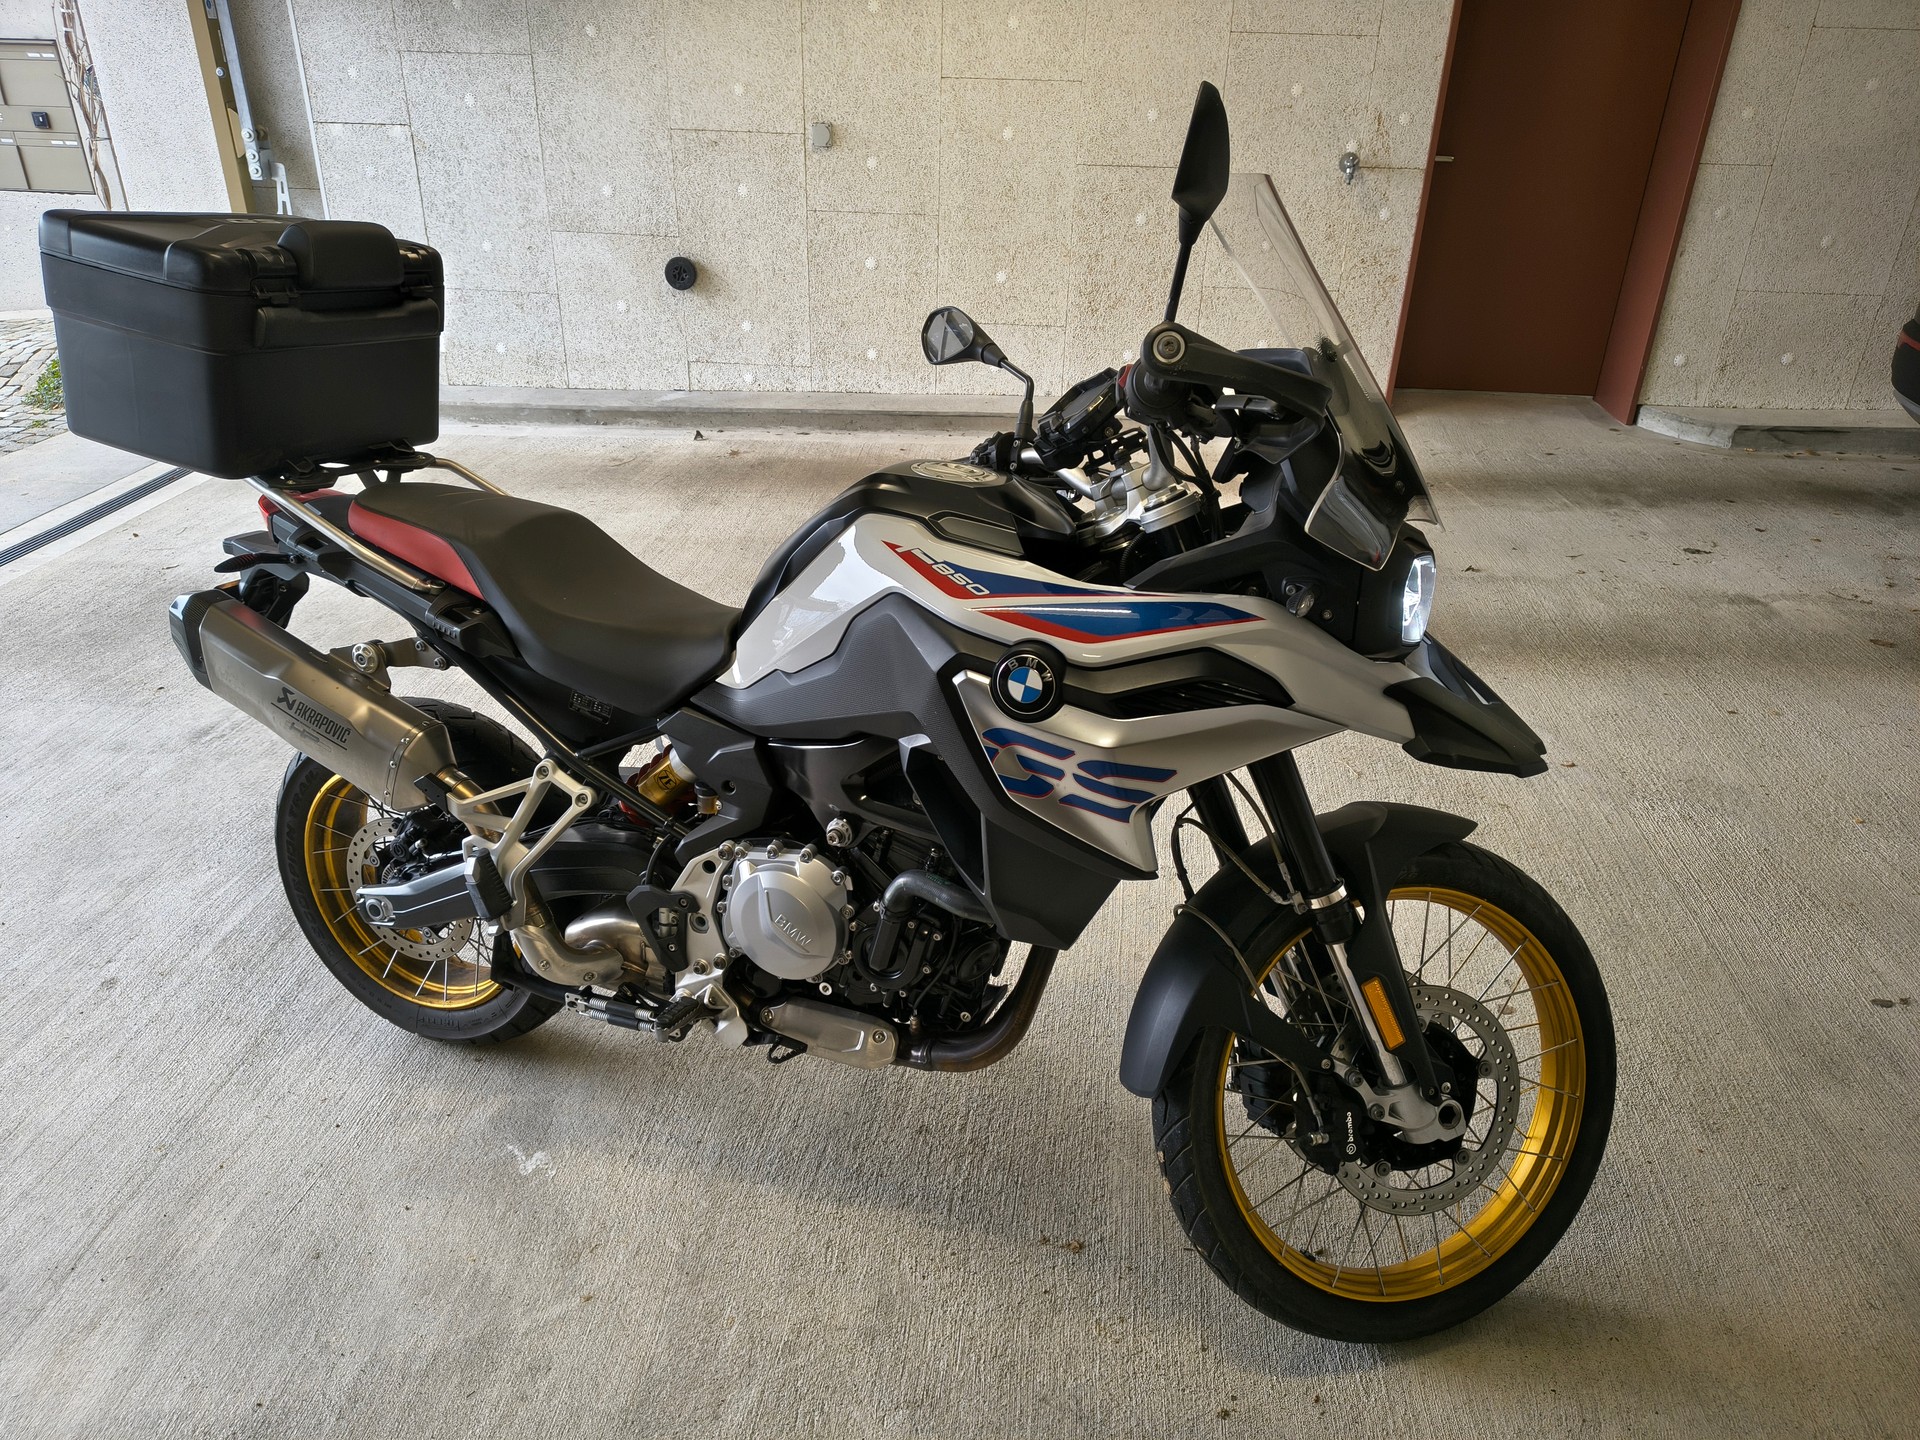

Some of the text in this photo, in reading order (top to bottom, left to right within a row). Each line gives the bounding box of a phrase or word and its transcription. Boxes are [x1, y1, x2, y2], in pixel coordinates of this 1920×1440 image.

[1008, 657, 1053, 682] BMW
[982, 727, 1177, 823] GS
[774, 913, 812, 946] BMW
[1345, 1111, 1354, 1142] brembo
